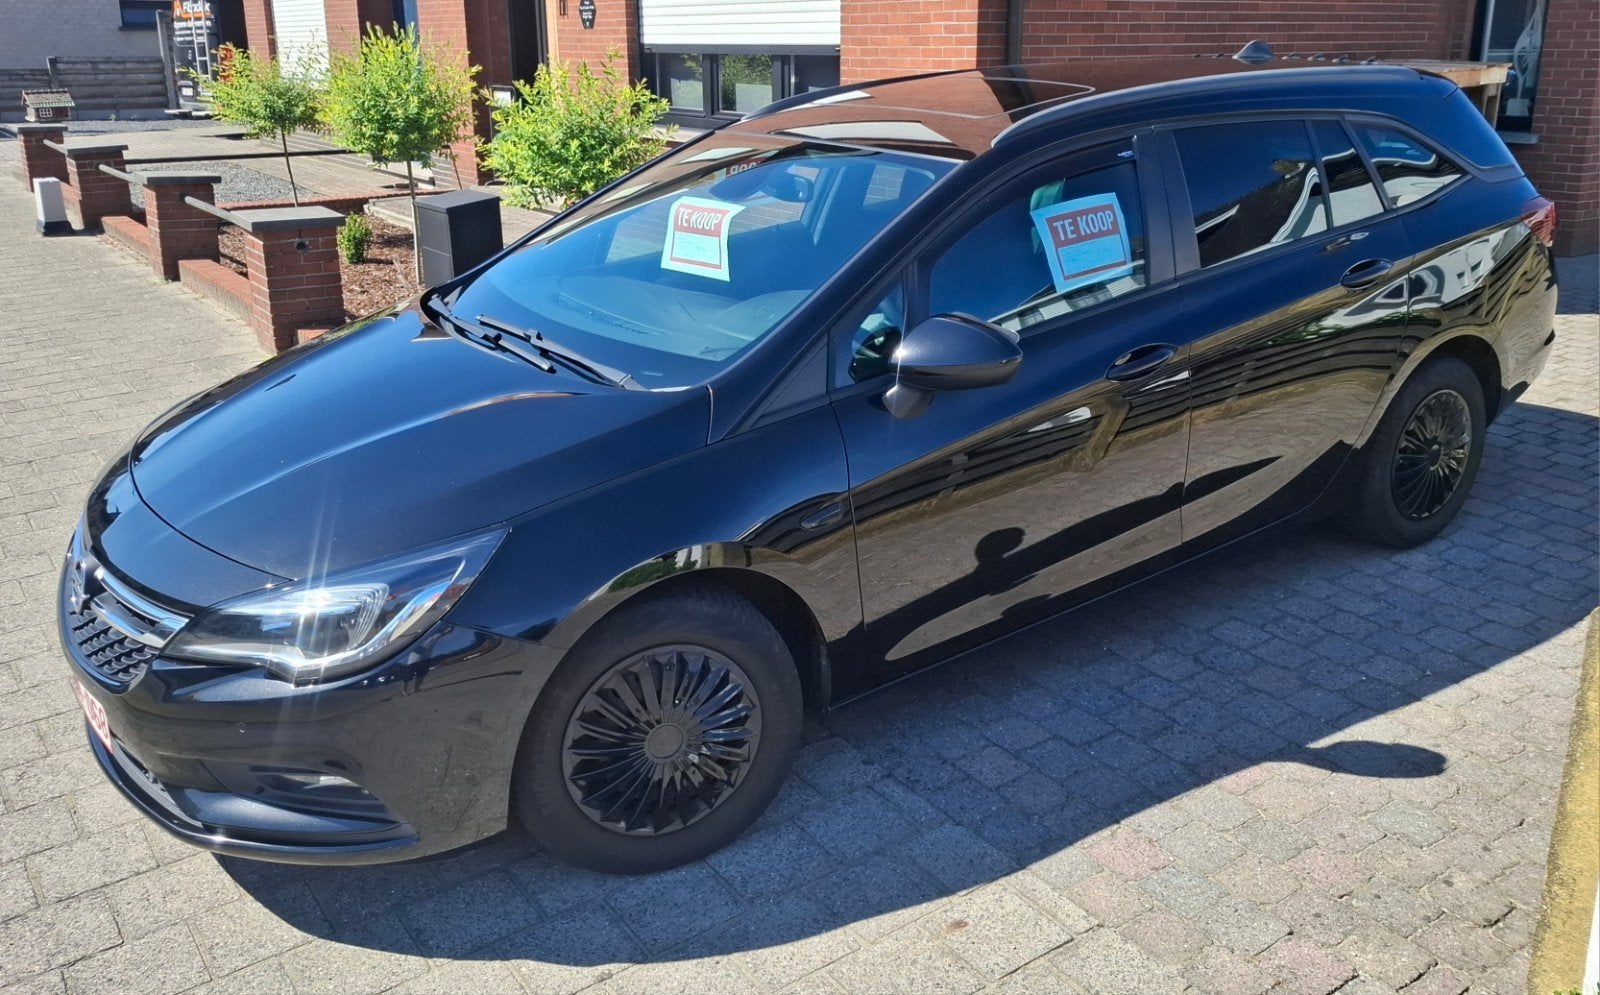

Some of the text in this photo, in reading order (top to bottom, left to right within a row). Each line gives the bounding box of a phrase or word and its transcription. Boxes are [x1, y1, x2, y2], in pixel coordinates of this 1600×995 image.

[678, 208, 722, 231] TE KOOP
[1053, 210, 1114, 241] TE KOOP
